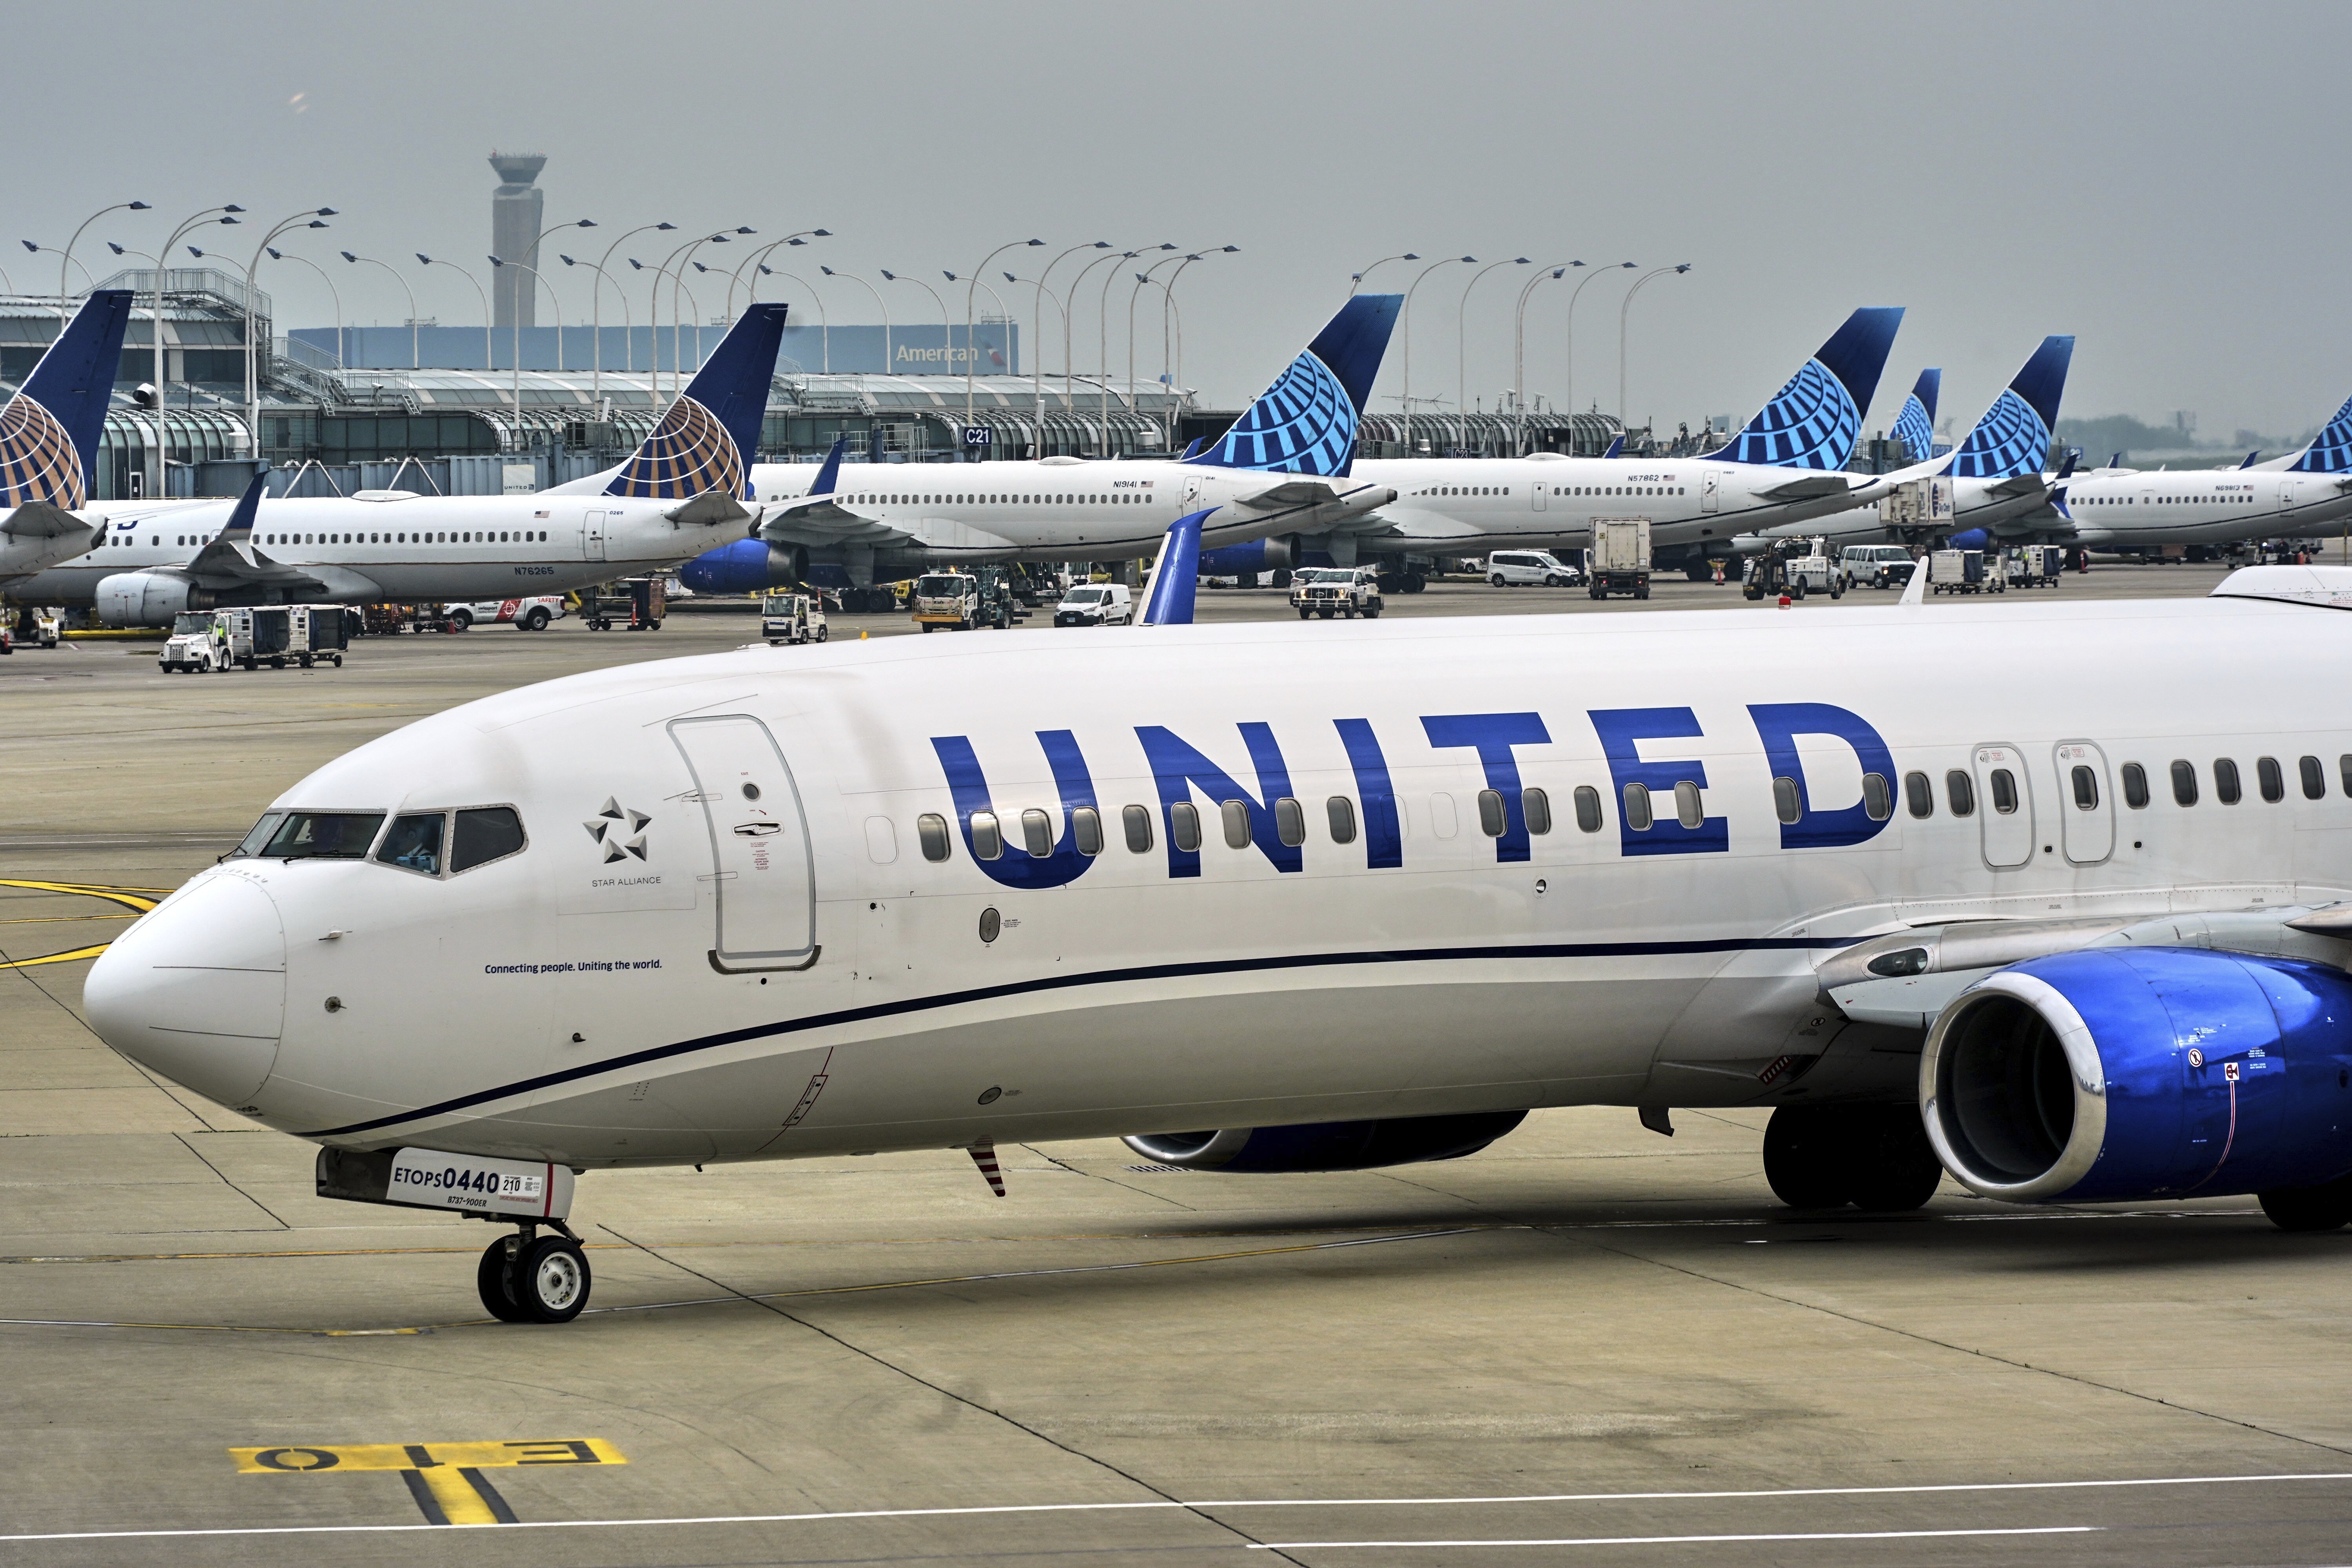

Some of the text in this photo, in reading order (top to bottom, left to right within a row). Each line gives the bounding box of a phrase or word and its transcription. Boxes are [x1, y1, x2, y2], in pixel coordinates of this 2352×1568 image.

[895, 345, 978, 362] American
[967, 428, 989, 443] C21
[1455, 449, 1468, 458] C23
[515, 567, 554, 575] N76265
[931, 702, 1899, 889] UNITED
[617, 877, 661, 885] ALLIANCE
[485, 959, 662, 974] Connecting people. Uniting the world.
[503, 1180, 520, 1191] 210
[447, 1196, 487, 1207] B737-900ER
